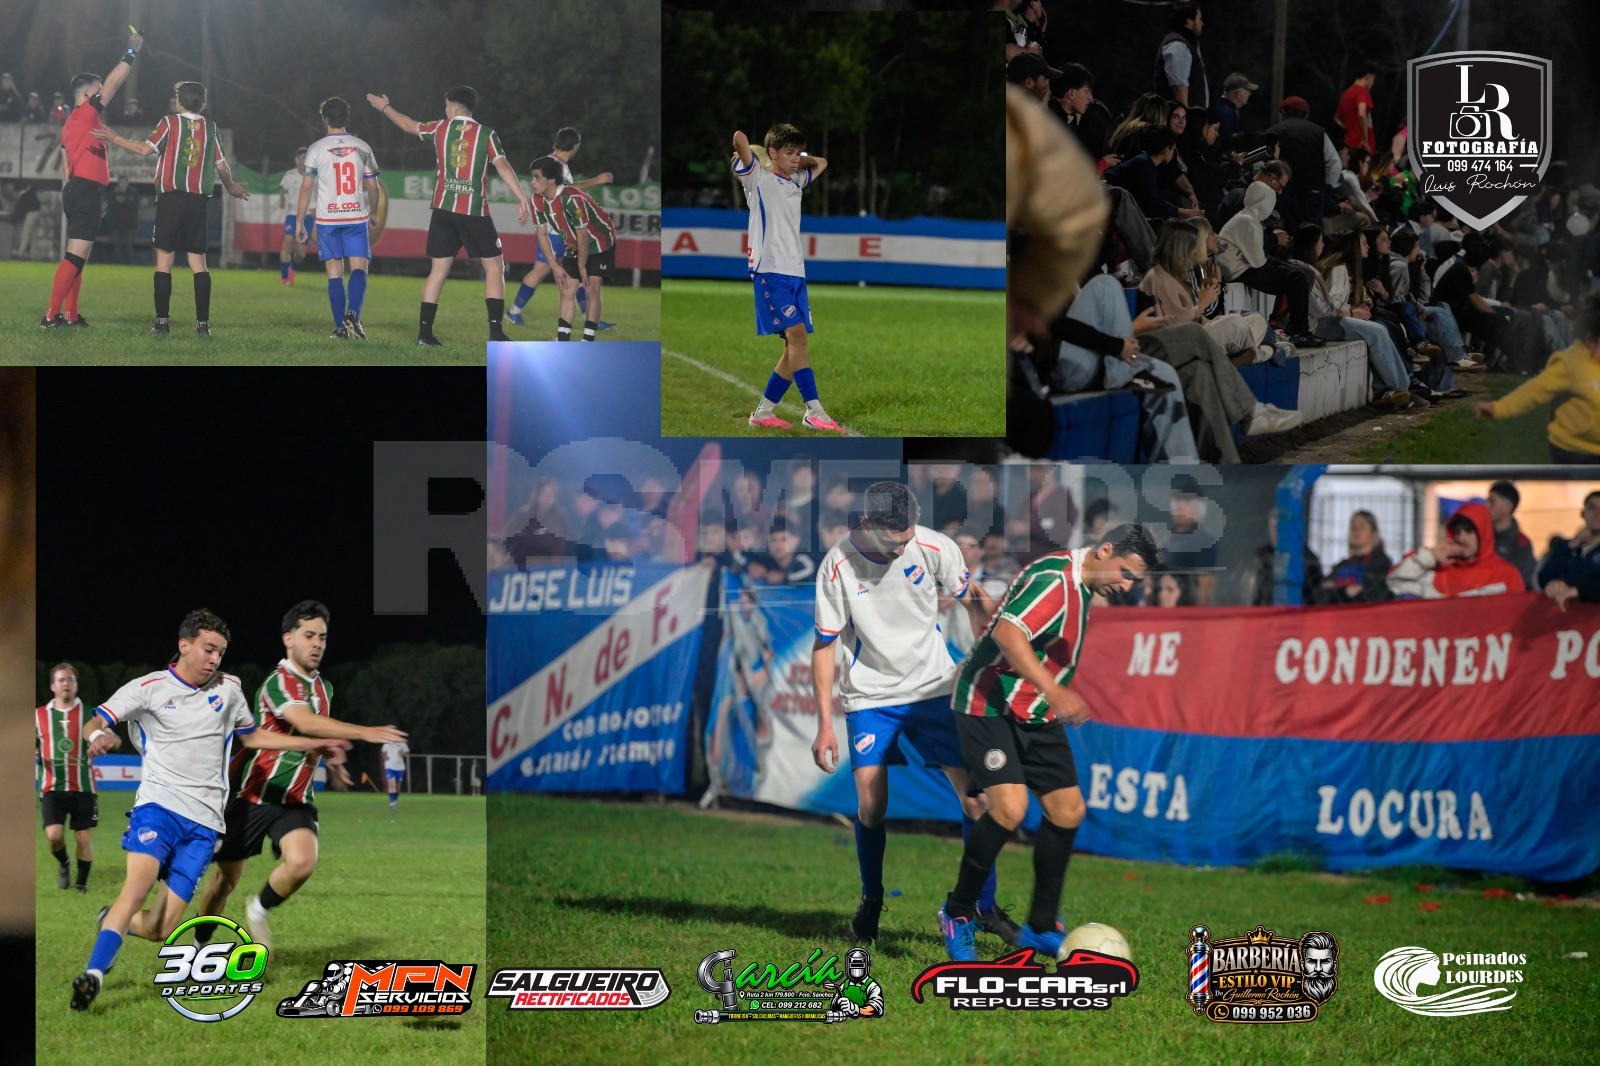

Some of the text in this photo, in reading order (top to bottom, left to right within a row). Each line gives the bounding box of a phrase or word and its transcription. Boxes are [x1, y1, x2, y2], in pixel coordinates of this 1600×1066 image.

[332, 161, 357, 196] 13
[489, 566, 636, 613] JOSE LUIS
[593, 625, 630, 686] de
[1126, 631, 1182, 677] ME
[1274, 632, 1513, 687] CONDENEN
[1087, 763, 1493, 840] ESTA LOCURA
